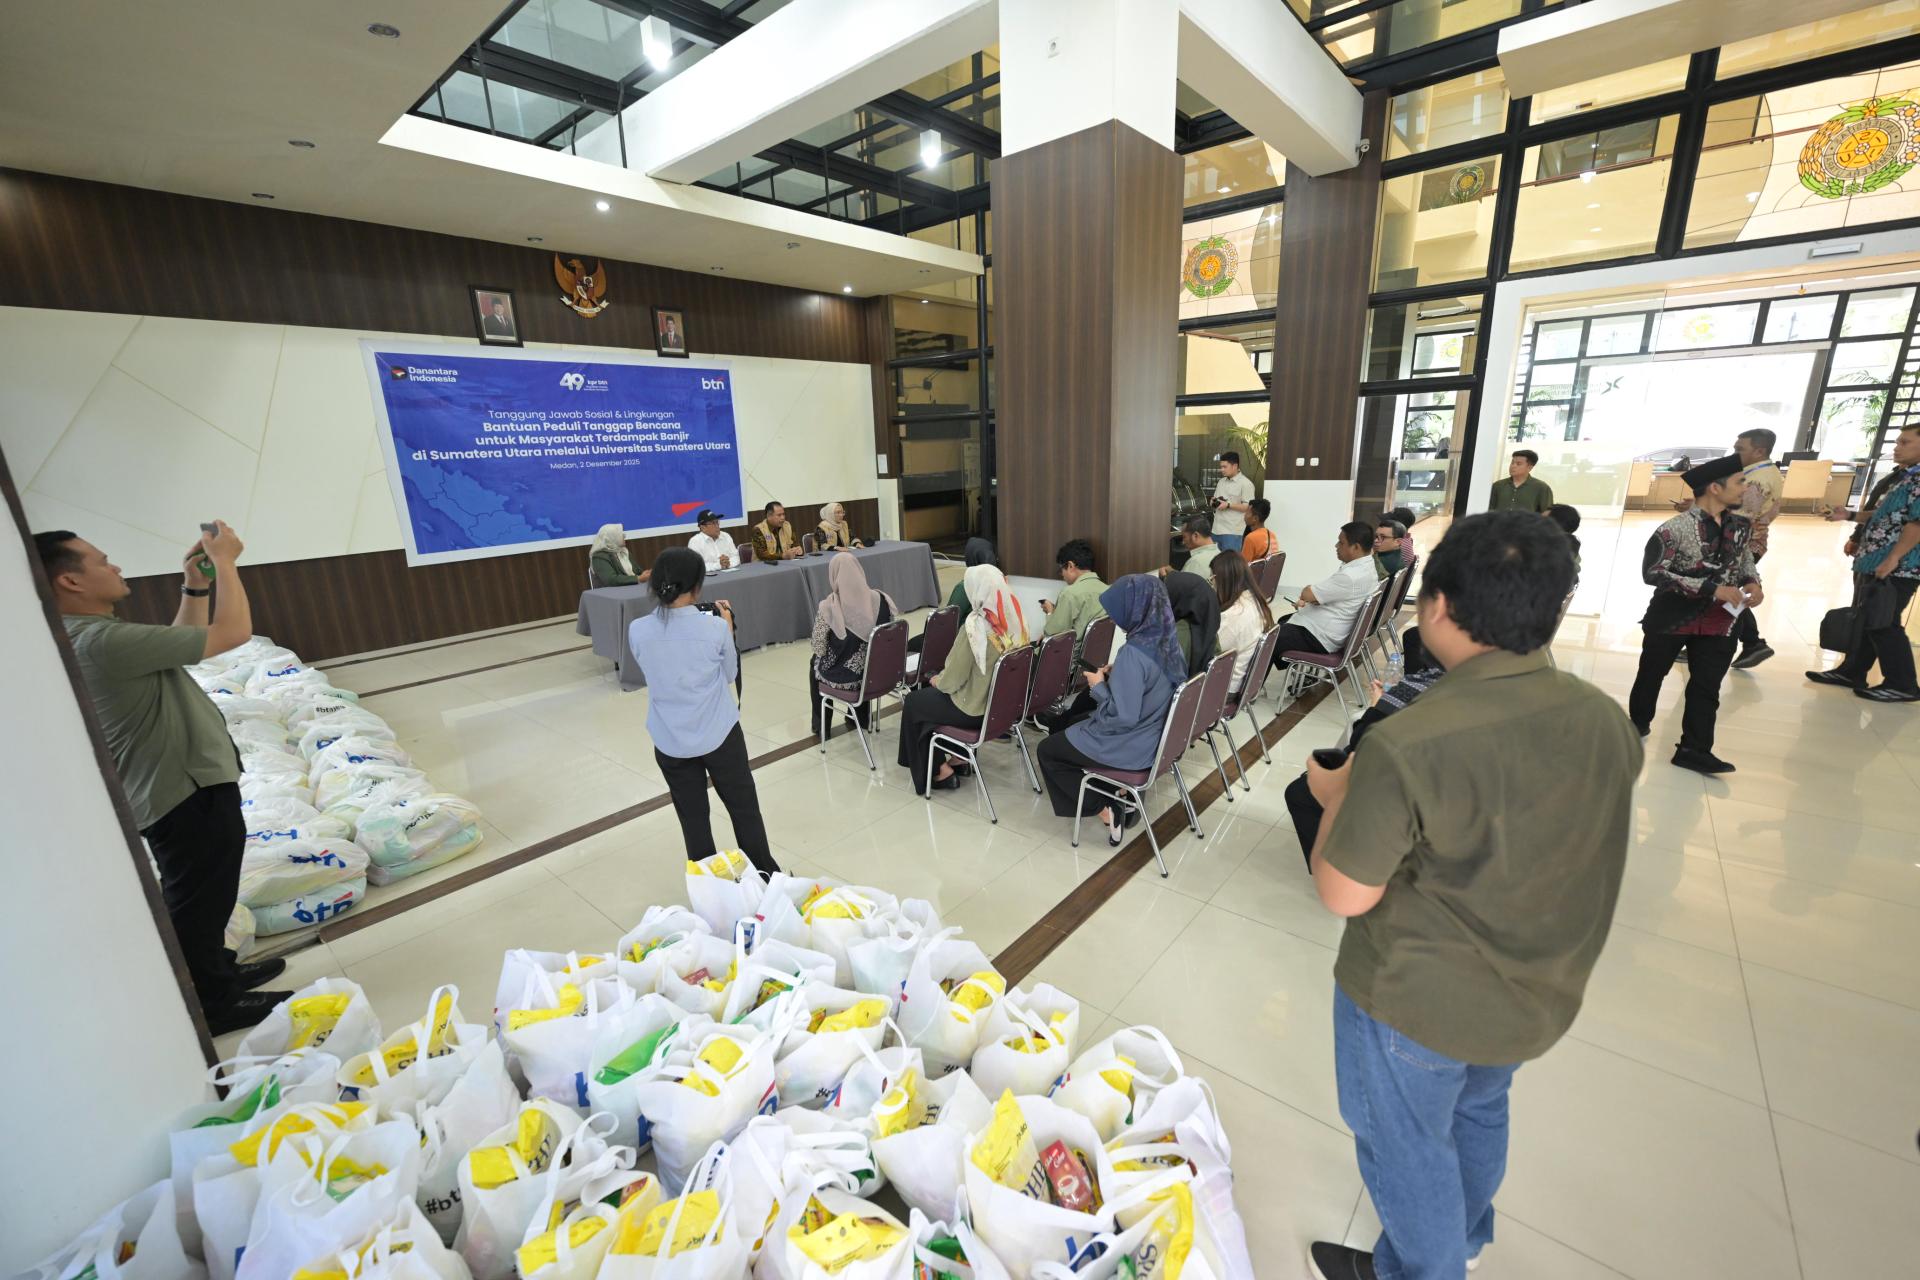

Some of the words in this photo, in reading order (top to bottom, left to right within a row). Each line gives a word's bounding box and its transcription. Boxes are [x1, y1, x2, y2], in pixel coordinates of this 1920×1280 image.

[407, 366, 458, 375] Danantara
[409, 374, 457, 383] Indonesia
[559, 372, 585, 391] 49
[702, 376, 725, 390] btn
[488, 410, 546, 421] Tanggung
[549, 410, 583, 419] Jawab
[585, 410, 613, 419] Sosial
[615, 411, 622, 419] &
[624, 410, 675, 420] Lingkungan
[483, 422, 541, 432] Bantuan
[543, 421, 581, 431] Peduli
[582, 421, 634, 433] Tanggap
[635, 420, 681, 430] Bencana
[475, 435, 517, 446] untuk
[519, 433, 594, 447] Masyarakat
[595, 432, 659, 444] Terdampak
[660, 431, 690, 442] Banjir
[412, 450, 427, 461] di
[430, 449, 503, 460] Sumatera
[505, 447, 542, 457] Utara
[544, 445, 590, 456] melalui
[591, 443, 653, 455] Universitas
[655, 442, 704, 452] Sumatera
[705, 441, 731, 450] Utara
[550, 461, 579, 470] Medan,
[580, 460, 586, 468] 2
[586, 459, 623, 468] Desember
[623, 458, 641, 466] 2025
[292, 899, 353, 923] btn
